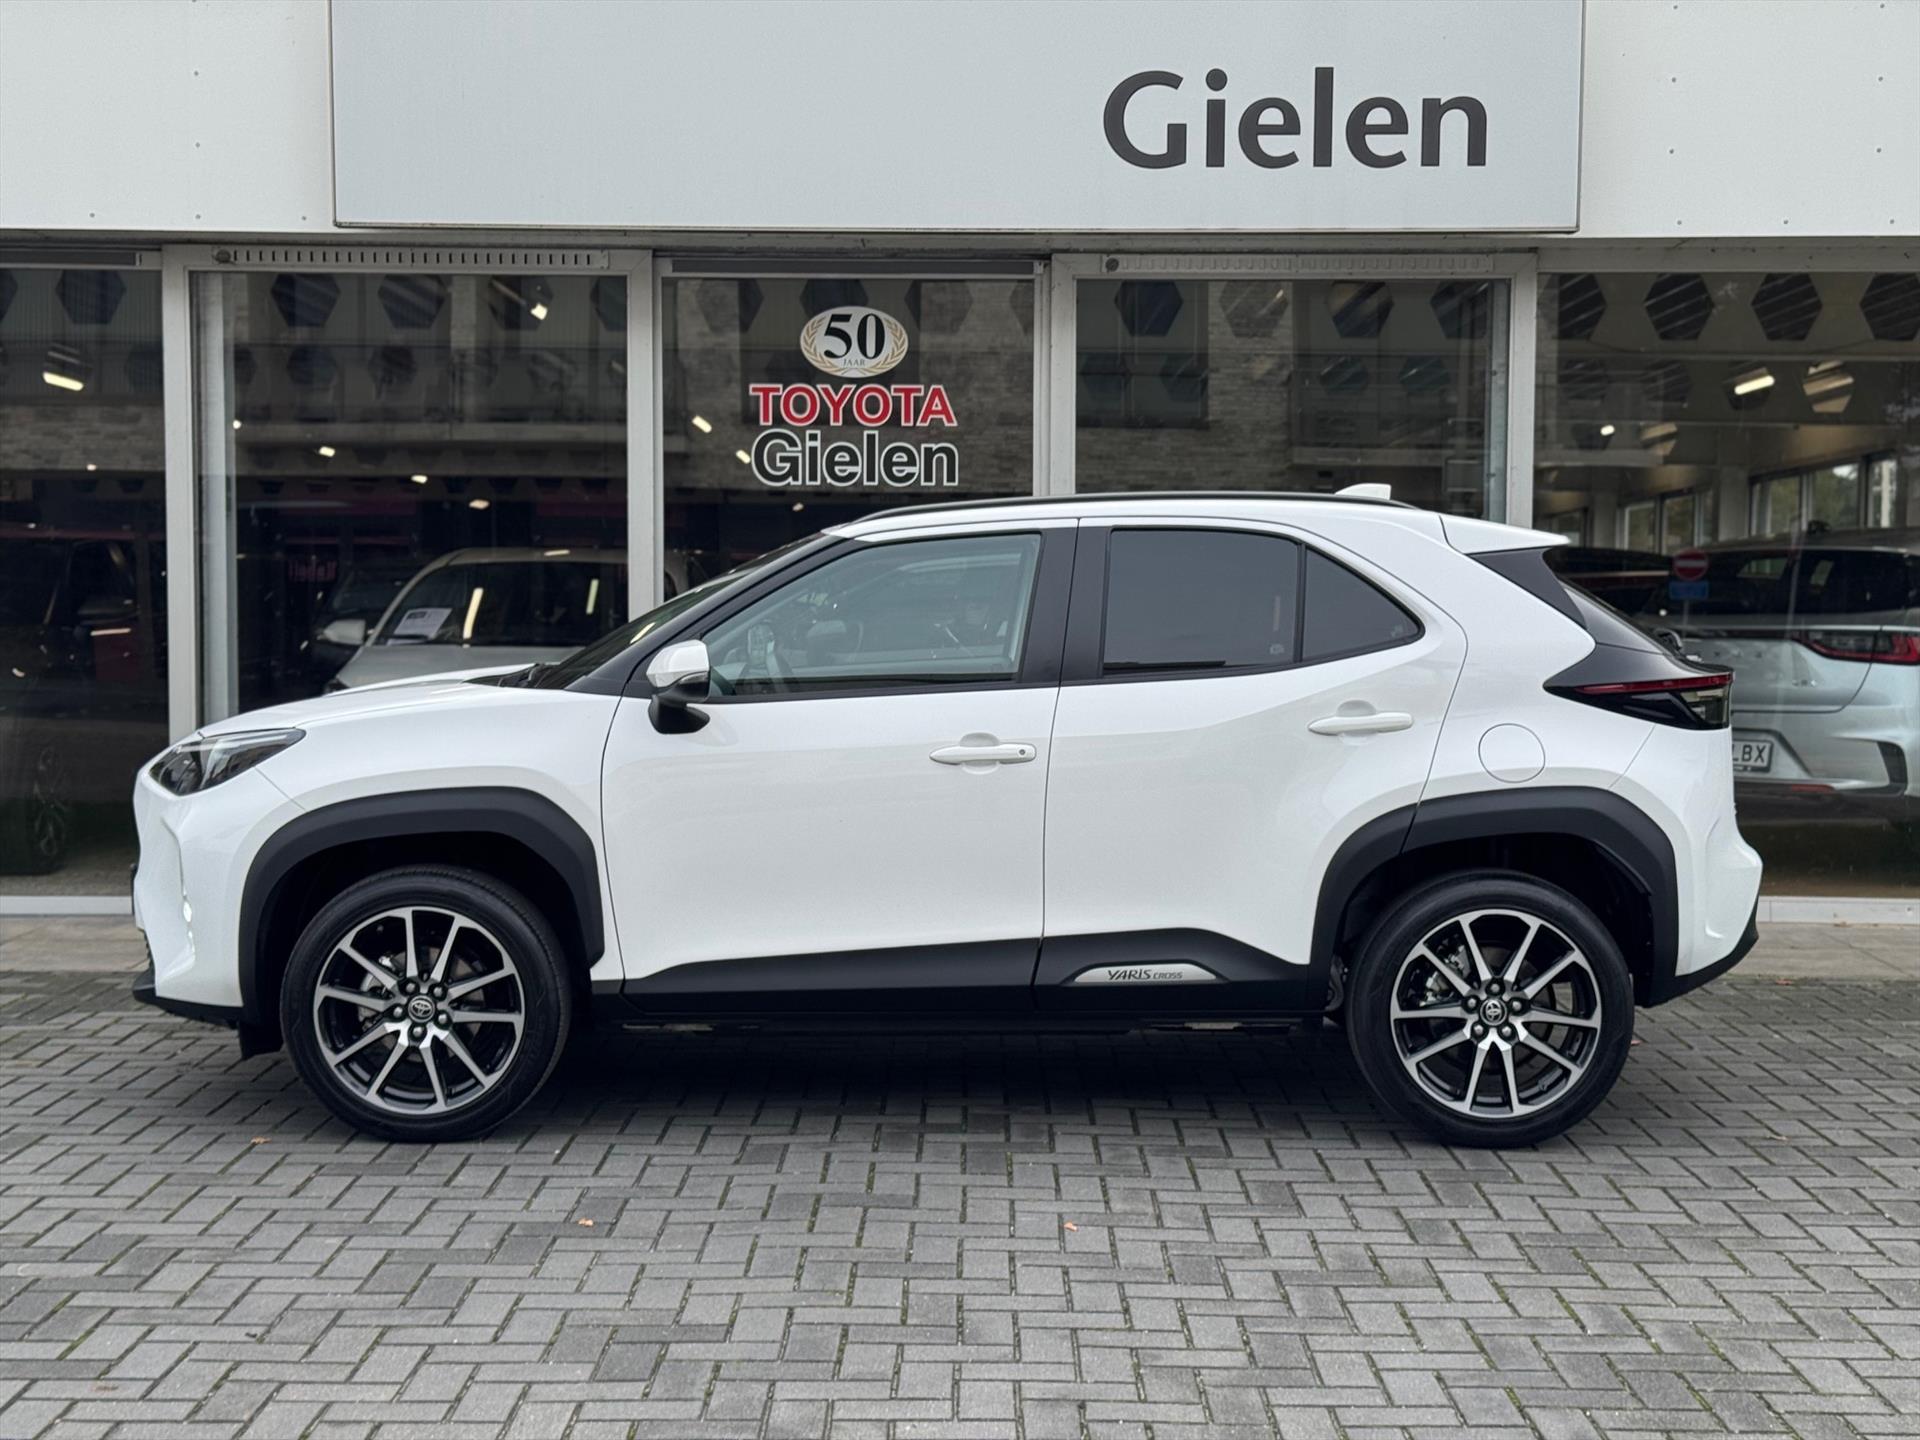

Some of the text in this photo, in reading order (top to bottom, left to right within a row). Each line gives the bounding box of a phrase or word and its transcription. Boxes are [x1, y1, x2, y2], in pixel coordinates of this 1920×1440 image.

[1103, 66, 1487, 169] Gielen
[824, 313, 886, 359] 50
[842, 359, 866, 367] JAAR
[749, 384, 958, 427] TOYOTA
[751, 428, 959, 487] Gielen
[1108, 969, 1183, 980] YARIS CROSS
